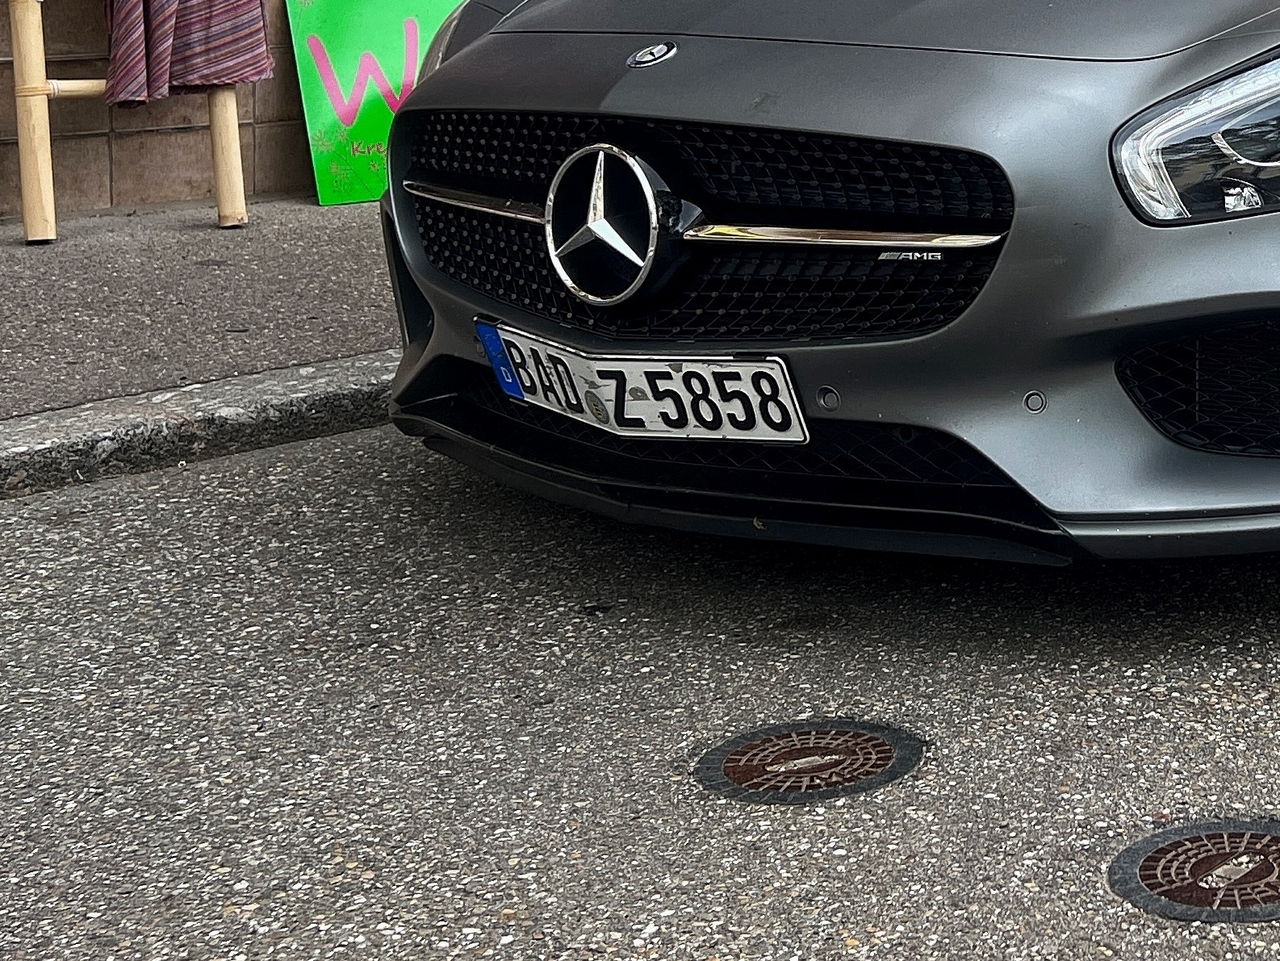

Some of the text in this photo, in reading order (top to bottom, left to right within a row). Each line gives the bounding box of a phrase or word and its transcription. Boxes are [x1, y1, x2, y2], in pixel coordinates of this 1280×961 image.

[898, 252, 942, 260] AMG
[502, 337, 793, 432] BAD Z 5858
